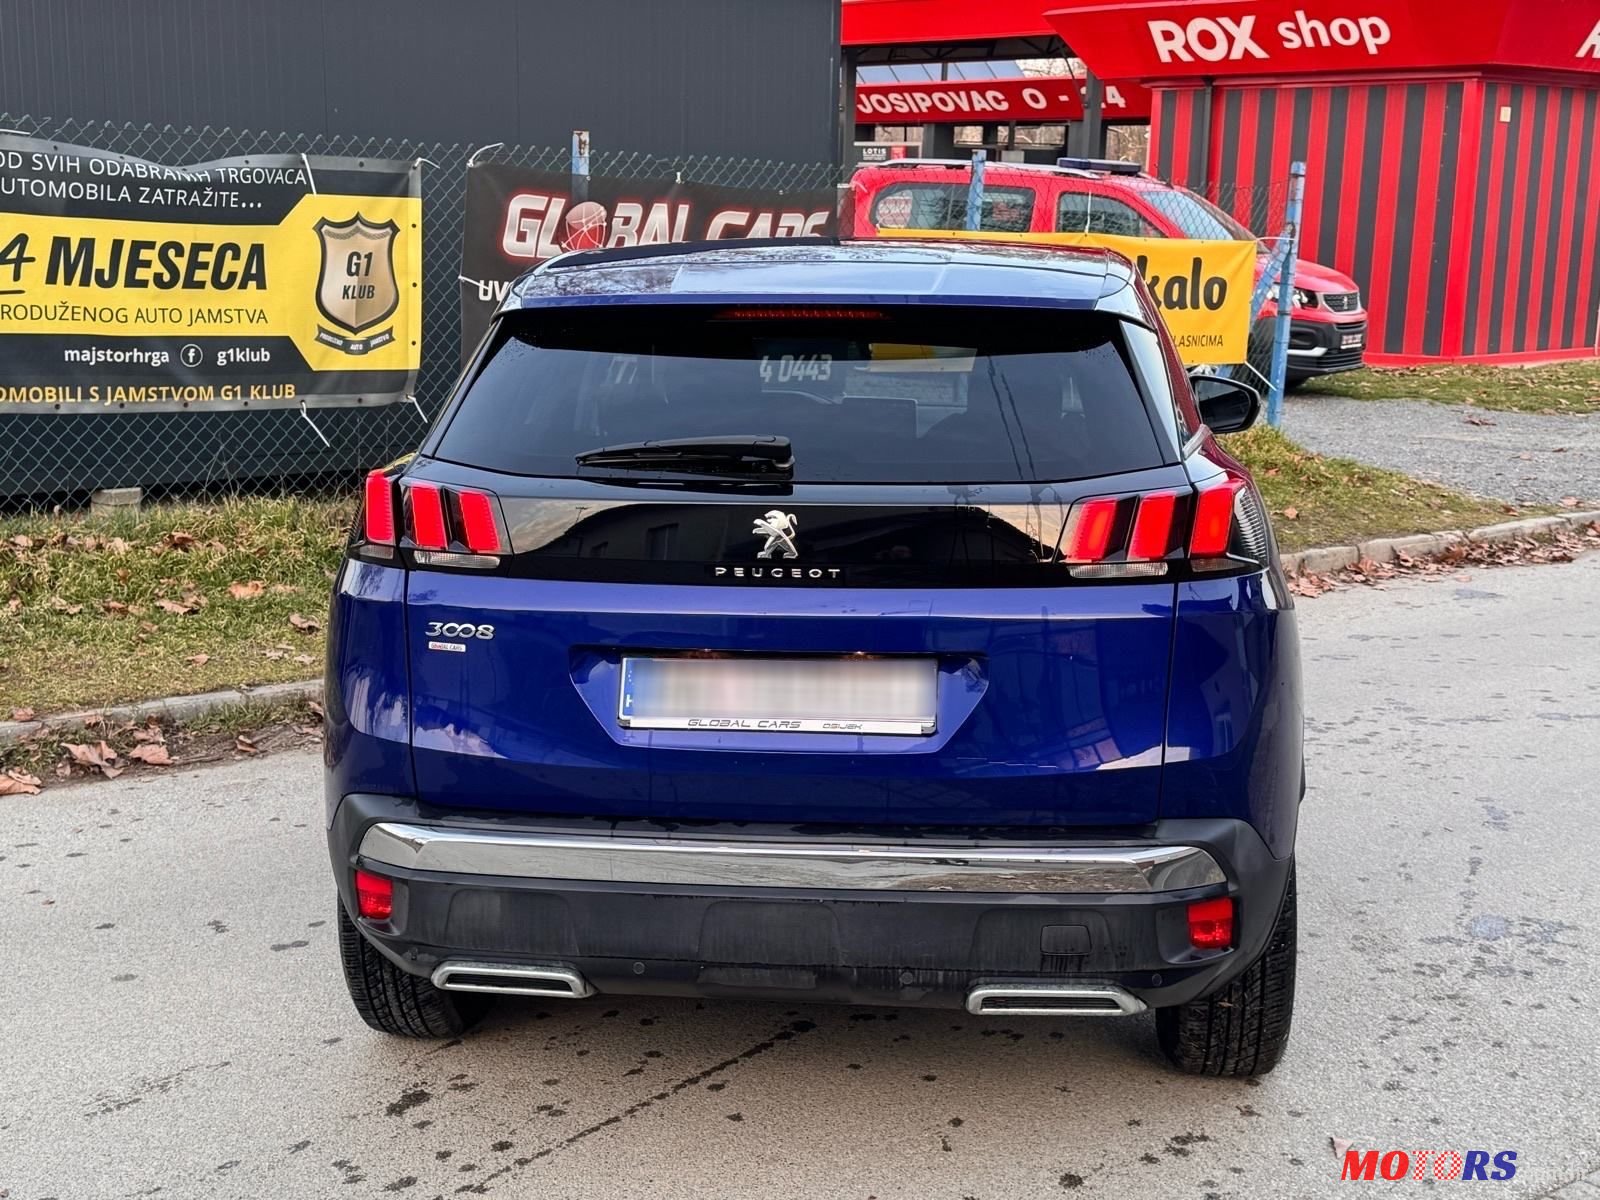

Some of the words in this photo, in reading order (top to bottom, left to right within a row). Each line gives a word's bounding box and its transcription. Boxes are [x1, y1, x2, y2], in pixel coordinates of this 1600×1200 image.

[1147, 15, 1270, 63] ROX
[1277, 9, 1391, 55] shop
[857, 89, 1009, 115] JOSIPOVAC
[1081, 85, 1127, 109] 4
[31, 153, 80, 174] SVIH
[89, 158, 211, 183] ODABRANIH
[216, 167, 307, 185] TRGOVACA
[138, 186, 262, 209] ZATRAŽITE...
[45, 235, 268, 290] MJESECA
[346, 251, 373, 277] G1
[342, 285, 375, 300] KLUB
[134, 307, 182, 323] AUTO
[187, 308, 268, 327] JAMSTVA
[64, 348, 169, 367] majstorhrga
[217, 348, 270, 366] g1klub
[89, 386, 99, 402] S
[104, 386, 214, 406] JAMSTVOM
[220, 385, 242, 400] G1
[250, 383, 296, 400] KLUB
[715, 567, 840, 578] PEUGEOT
[425, 621, 495, 640] 3008
[687, 718, 751, 728] GLOBAL
[757, 720, 802, 729] CARS
